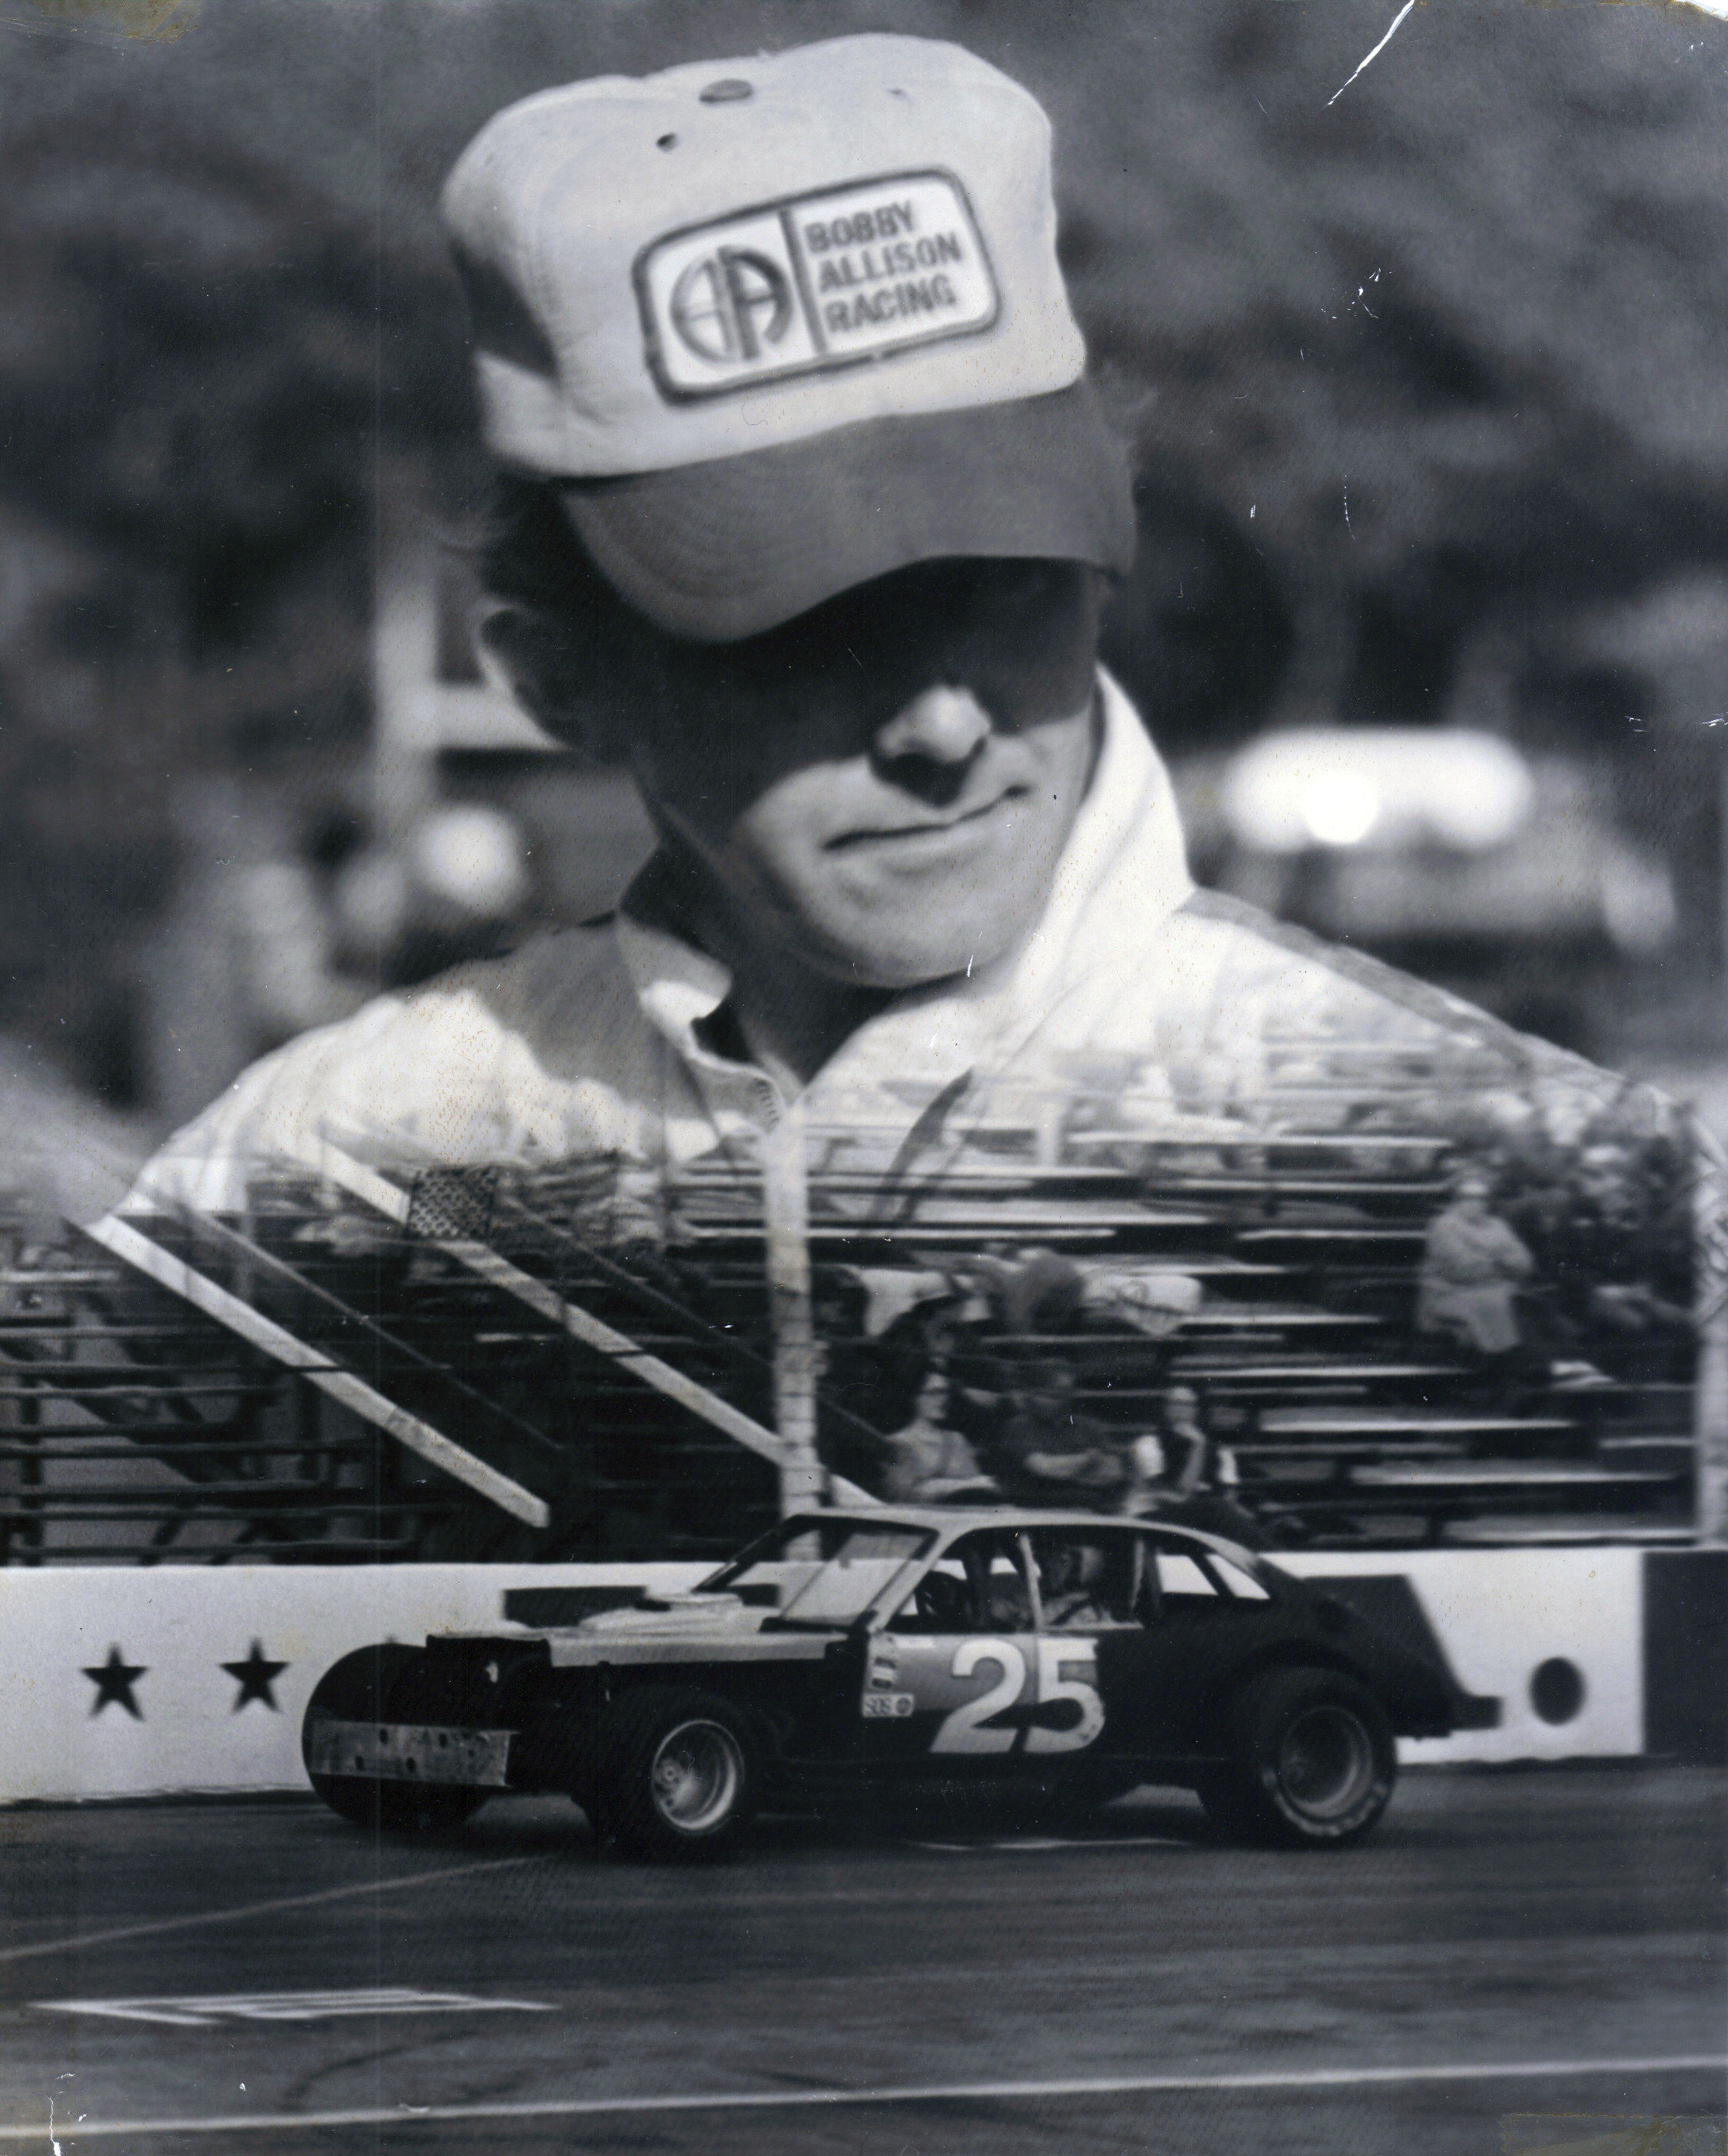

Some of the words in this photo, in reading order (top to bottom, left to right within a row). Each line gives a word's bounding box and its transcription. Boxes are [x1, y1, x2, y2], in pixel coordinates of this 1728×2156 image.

[806, 201, 913, 254] BOBBY
[819, 231, 963, 294] ALLISON
[826, 274, 956, 333] RACING
[929, 1636, 1106, 1753] 25
